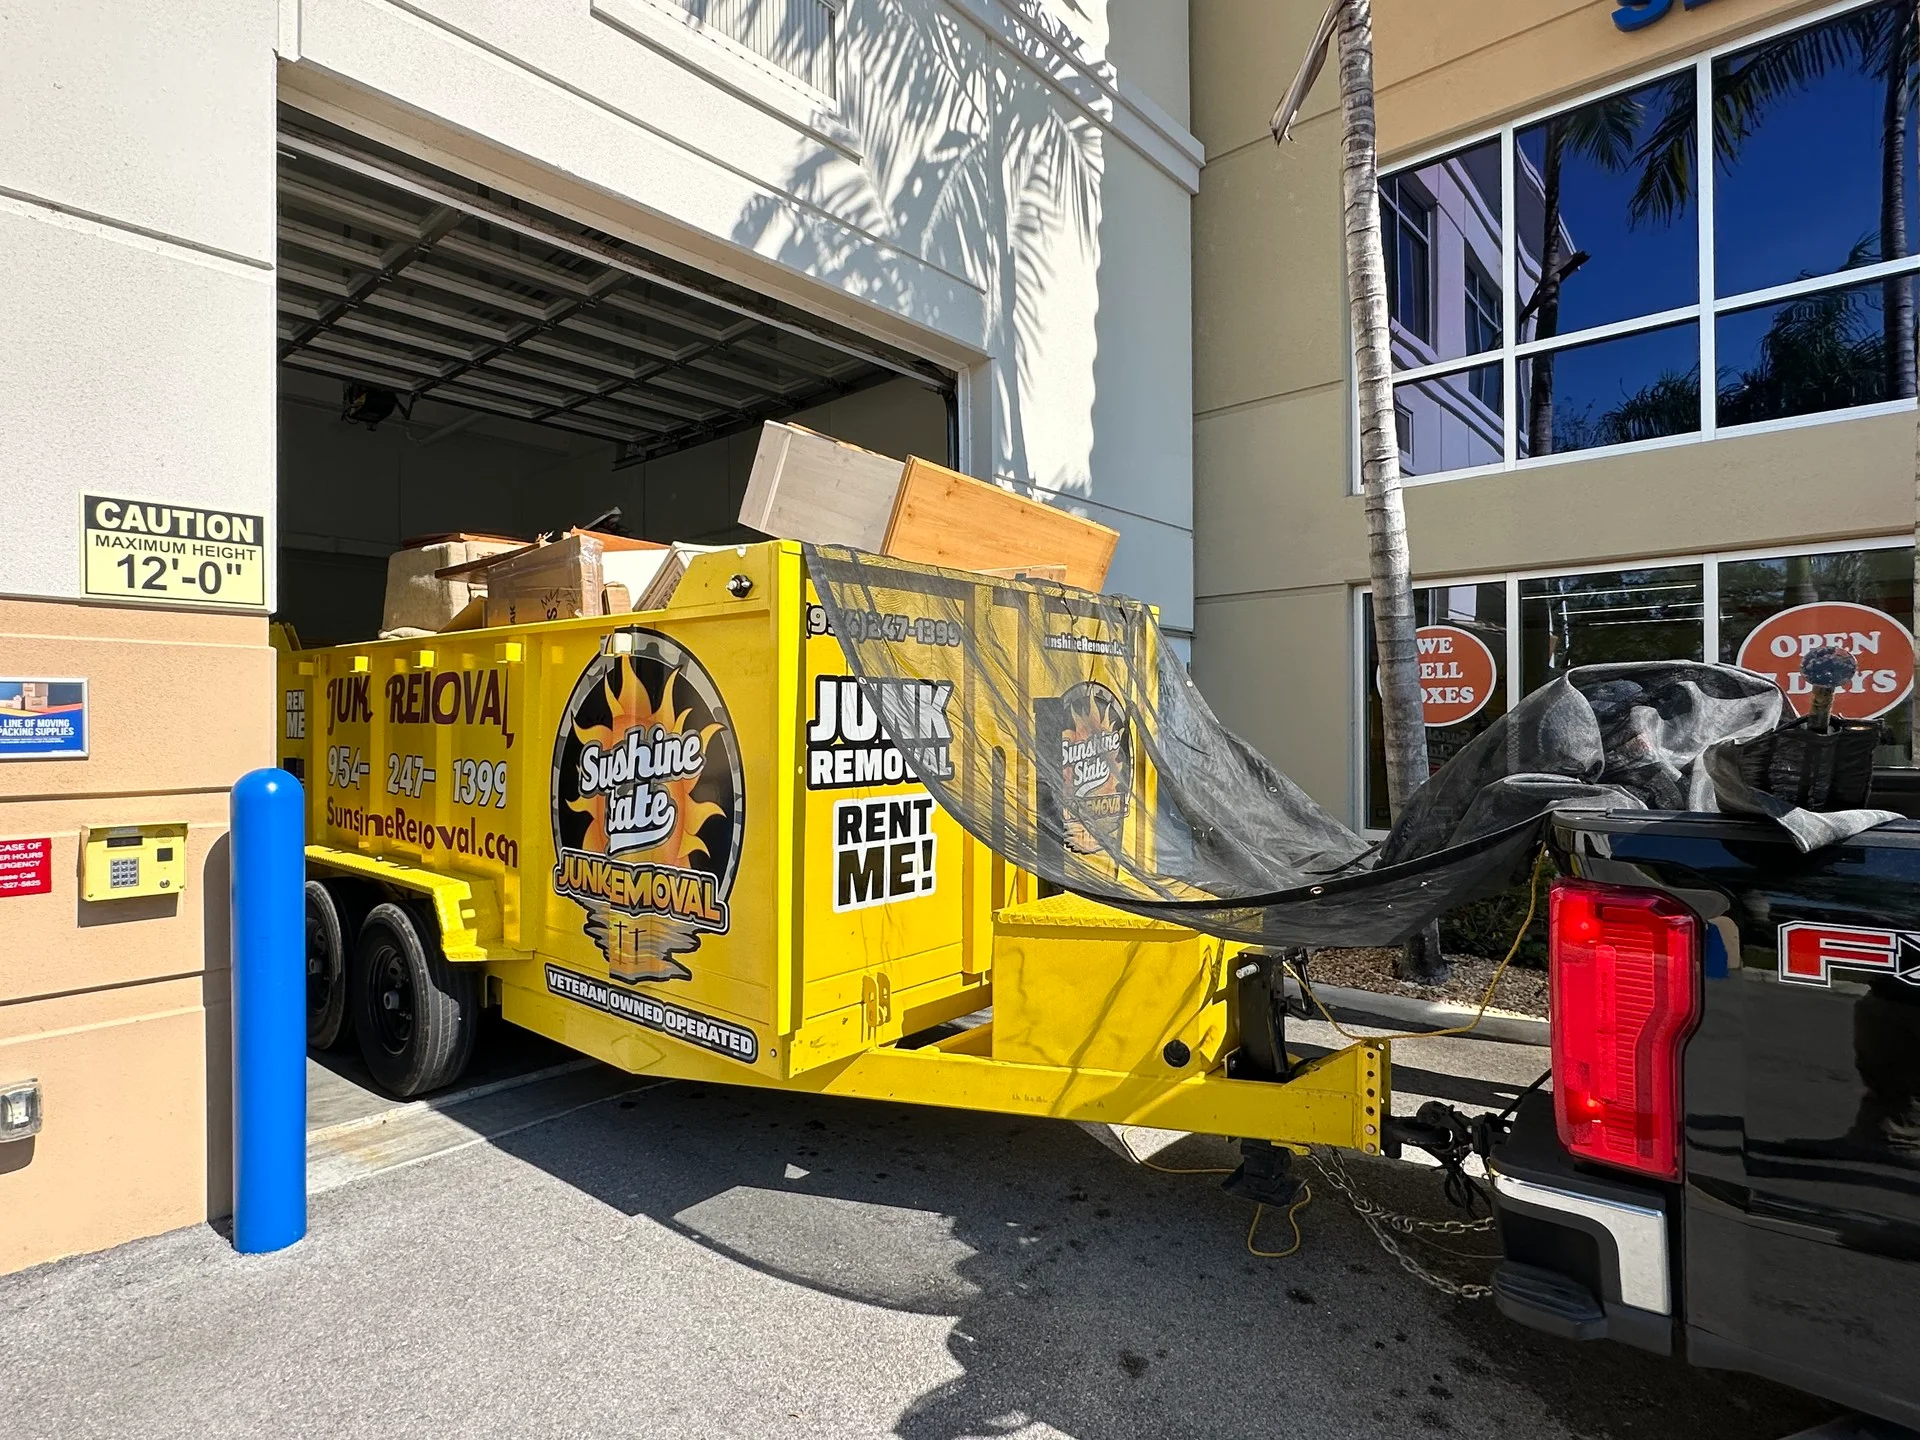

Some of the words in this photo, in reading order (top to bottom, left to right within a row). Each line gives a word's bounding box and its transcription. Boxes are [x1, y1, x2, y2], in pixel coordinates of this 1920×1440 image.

[95, 501, 254, 543] CAUTION
[95, 534, 186, 555] MAXIMUM
[192, 544, 256, 561] HEIGHT
[117, 553, 242, 595] 12'-0"
[1416, 637, 1454, 654] WE
[1770, 631, 1881, 658] OPEN
[1418, 662, 1464, 679] ELL
[1786, 669, 1897, 694] DYS
[286, 690, 305, 711] REN
[1421, 686, 1475, 704] XES
[4, 718, 23, 728] LINE
[24, 718, 36, 728] OF
[37, 718, 70, 728] MOVING
[286, 711, 305, 738] ME
[808, 679, 953, 743] JUNK
[35, 727, 75, 736] SUPPLIES
[579, 729, 705, 791] Sushine
[1073, 759, 1110, 787] State
[453, 758, 507, 809] 1399
[837, 798, 932, 846] RENT
[12, 851, 44, 860] HOURS
[27, 842, 42, 850] OF
[837, 840, 934, 907] ME!
[611, 868, 721, 921] EMOVAL
[548, 970, 607, 1005] VETERAN
[609, 992, 664, 1025] OWNED
[664, 1011, 753, 1055] OPERATED
